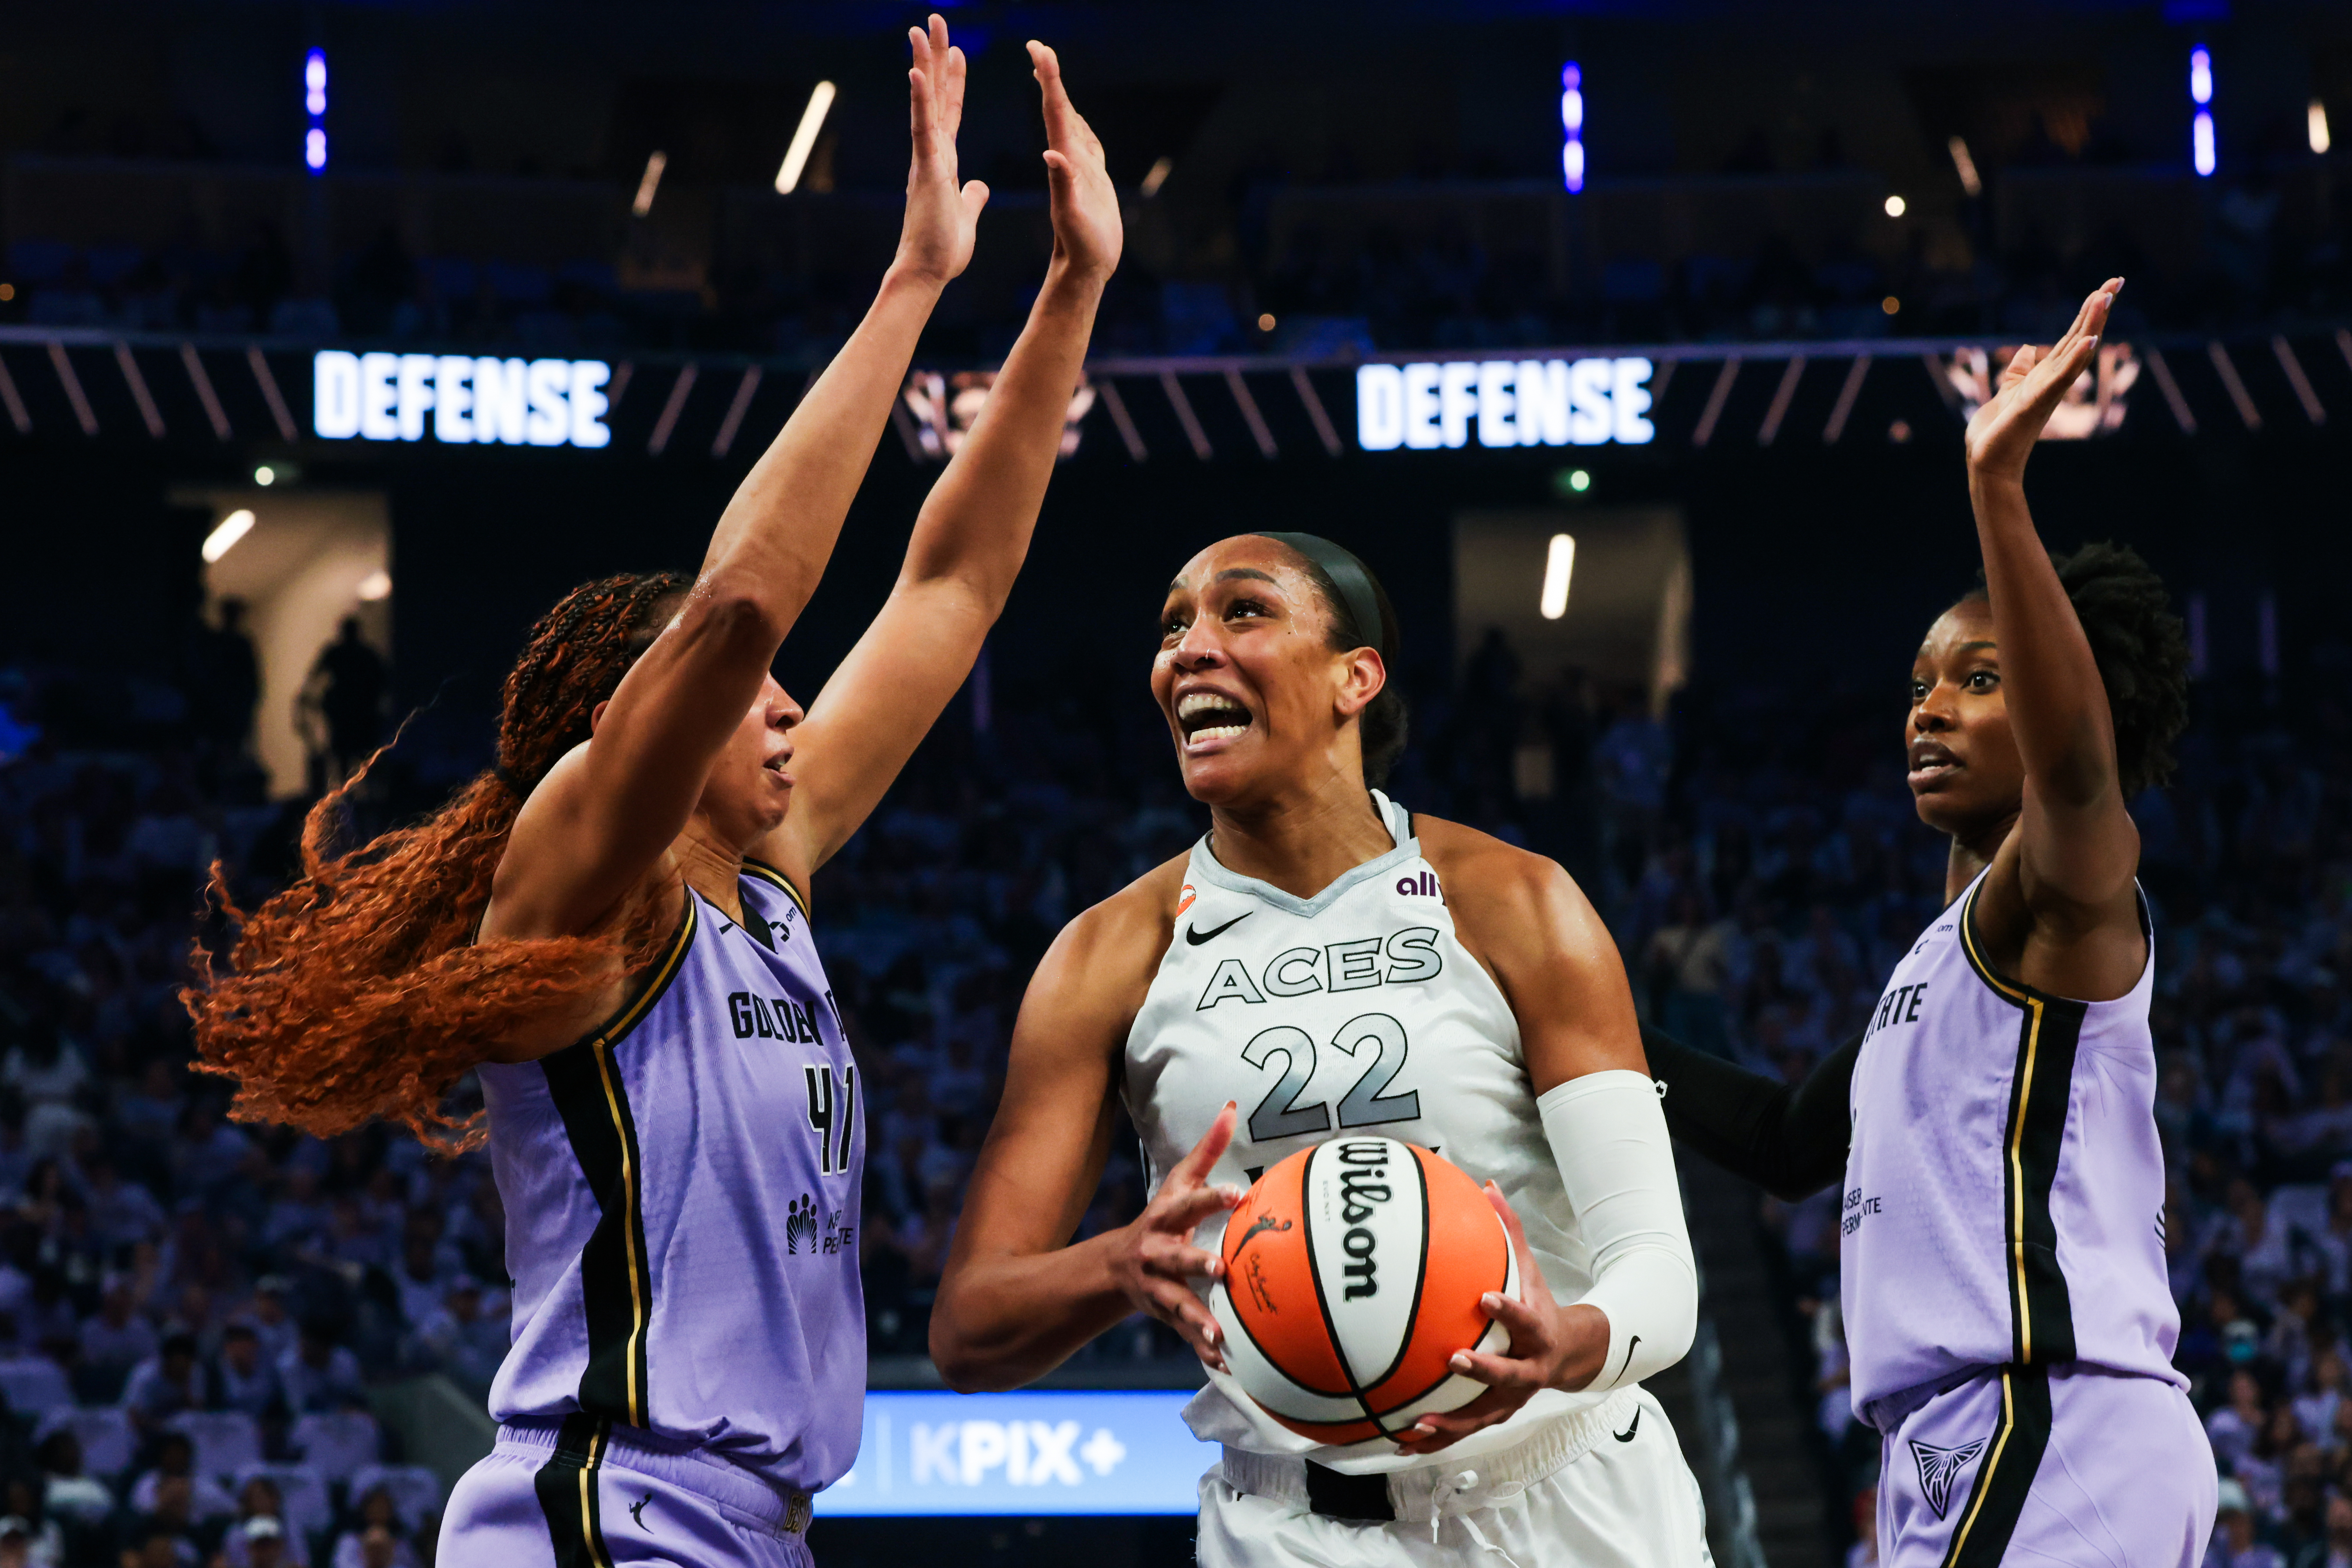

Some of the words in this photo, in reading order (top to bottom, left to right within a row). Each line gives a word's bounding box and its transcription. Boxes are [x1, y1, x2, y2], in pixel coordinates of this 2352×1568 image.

[313, 350, 611, 448] DEFENSE
[1356, 357, 1655, 451] DEFENSE
[1196, 927, 1443, 1011] ACES
[1865, 982, 1928, 1044] TATE
[728, 991, 824, 1046] GOLDEN
[802, 1062, 854, 1176] 41
[1241, 1012, 1421, 1142] 22
[1336, 1142, 1393, 1303] Wilson
[1842, 1188, 1862, 1213] AISER
[909, 1419, 1127, 1487] KPIX+
